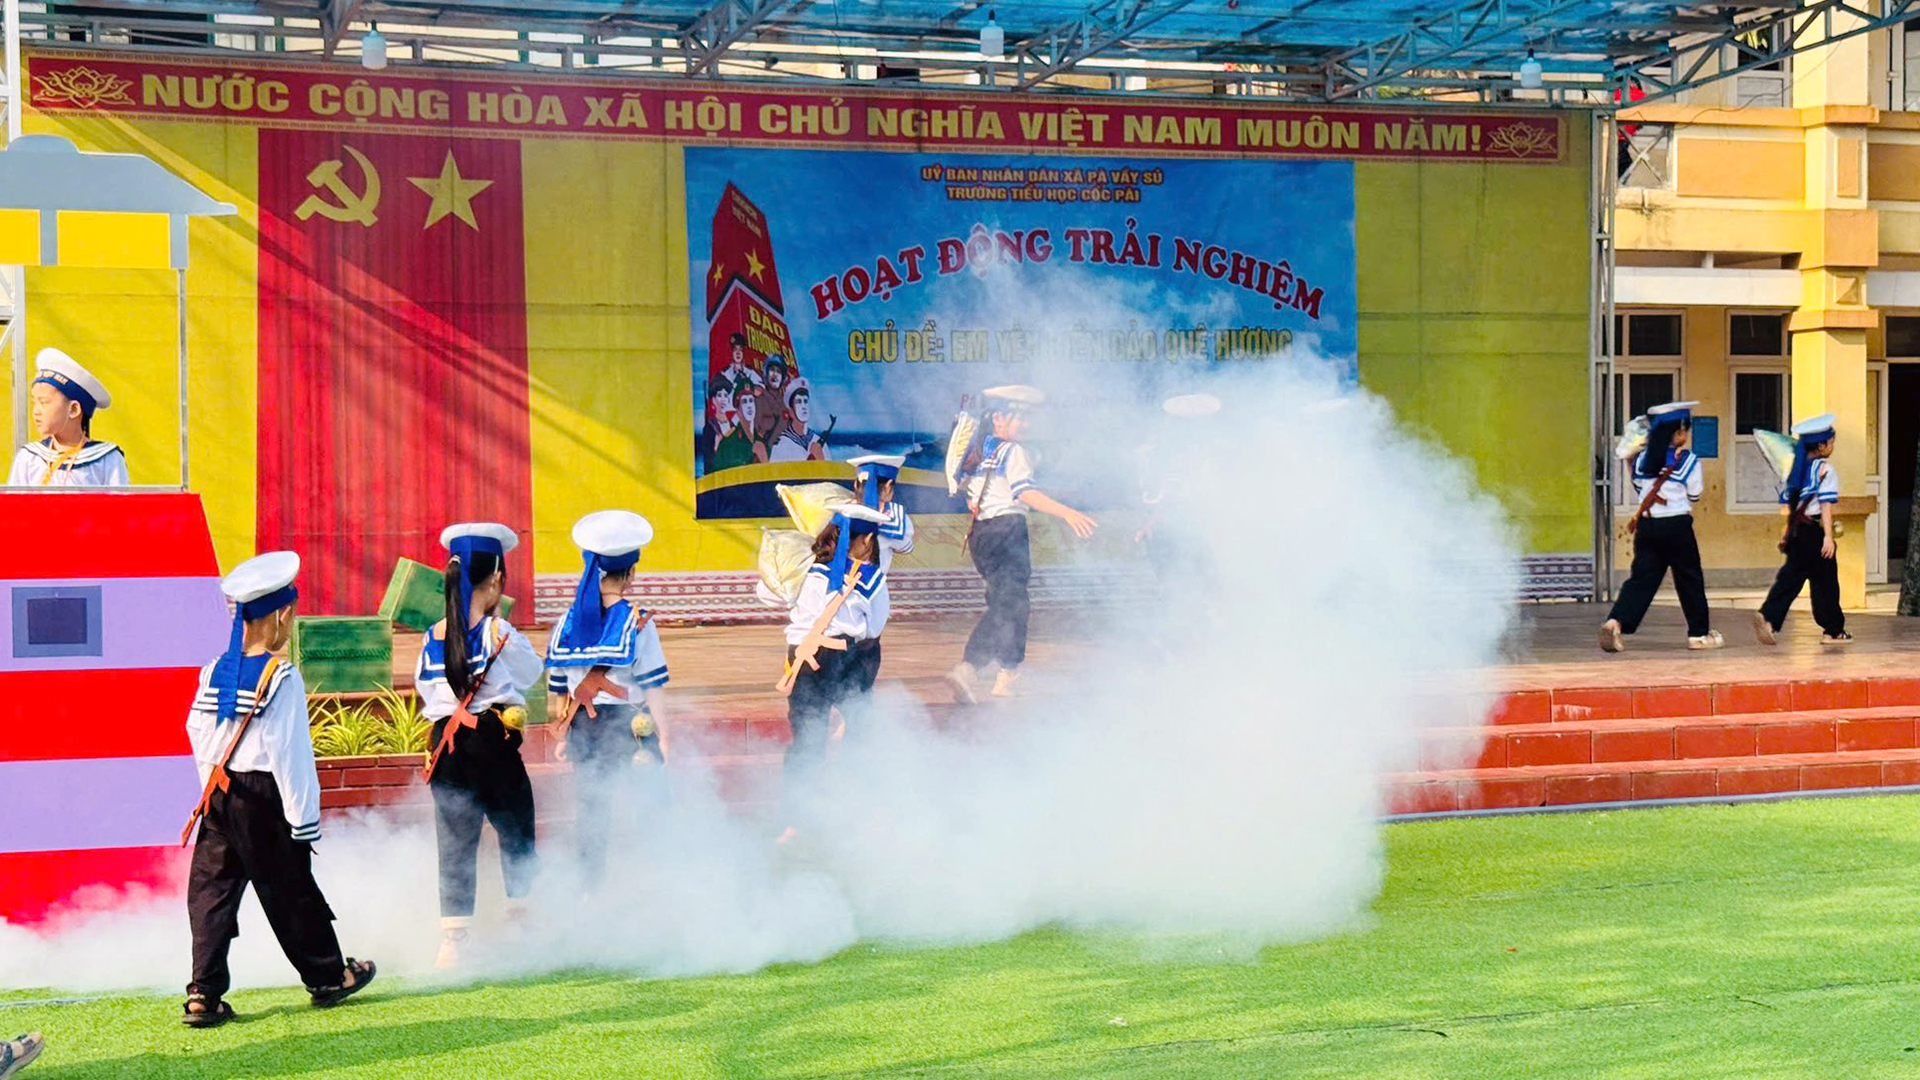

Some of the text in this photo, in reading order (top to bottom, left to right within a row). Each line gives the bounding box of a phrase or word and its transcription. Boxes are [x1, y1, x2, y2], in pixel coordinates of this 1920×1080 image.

[142, 73, 1481, 151] NƯỚC CỘNG HÒA XÃ HỘI CHỦ NGHĨA VIỆT NAM MUÔN NĂM!
[946, 184, 1007, 200] TRƯỜNG
[1010, 182, 1043, 200] TIỂU
[1047, 187, 1078, 203] HỌC
[947, 167, 978, 182] BAN
[982, 167, 1025, 183] NHÂN
[1028, 168, 1059, 183] DÂN
[1062, 167, 1083, 183] XÃ
[809, 217, 1325, 321] HOẠT ĐỘNG TRẢI NGHIỆM
[848, 318, 899, 364] CHỦ
[904, 319, 945, 364] ĐỀ:
[951, 329, 989, 363] EM
[1108, 319, 1158, 363] ĐẢO
[1164, 321, 1210, 365] QUÊ
[1214, 324, 1294, 362] HƯƠNG
